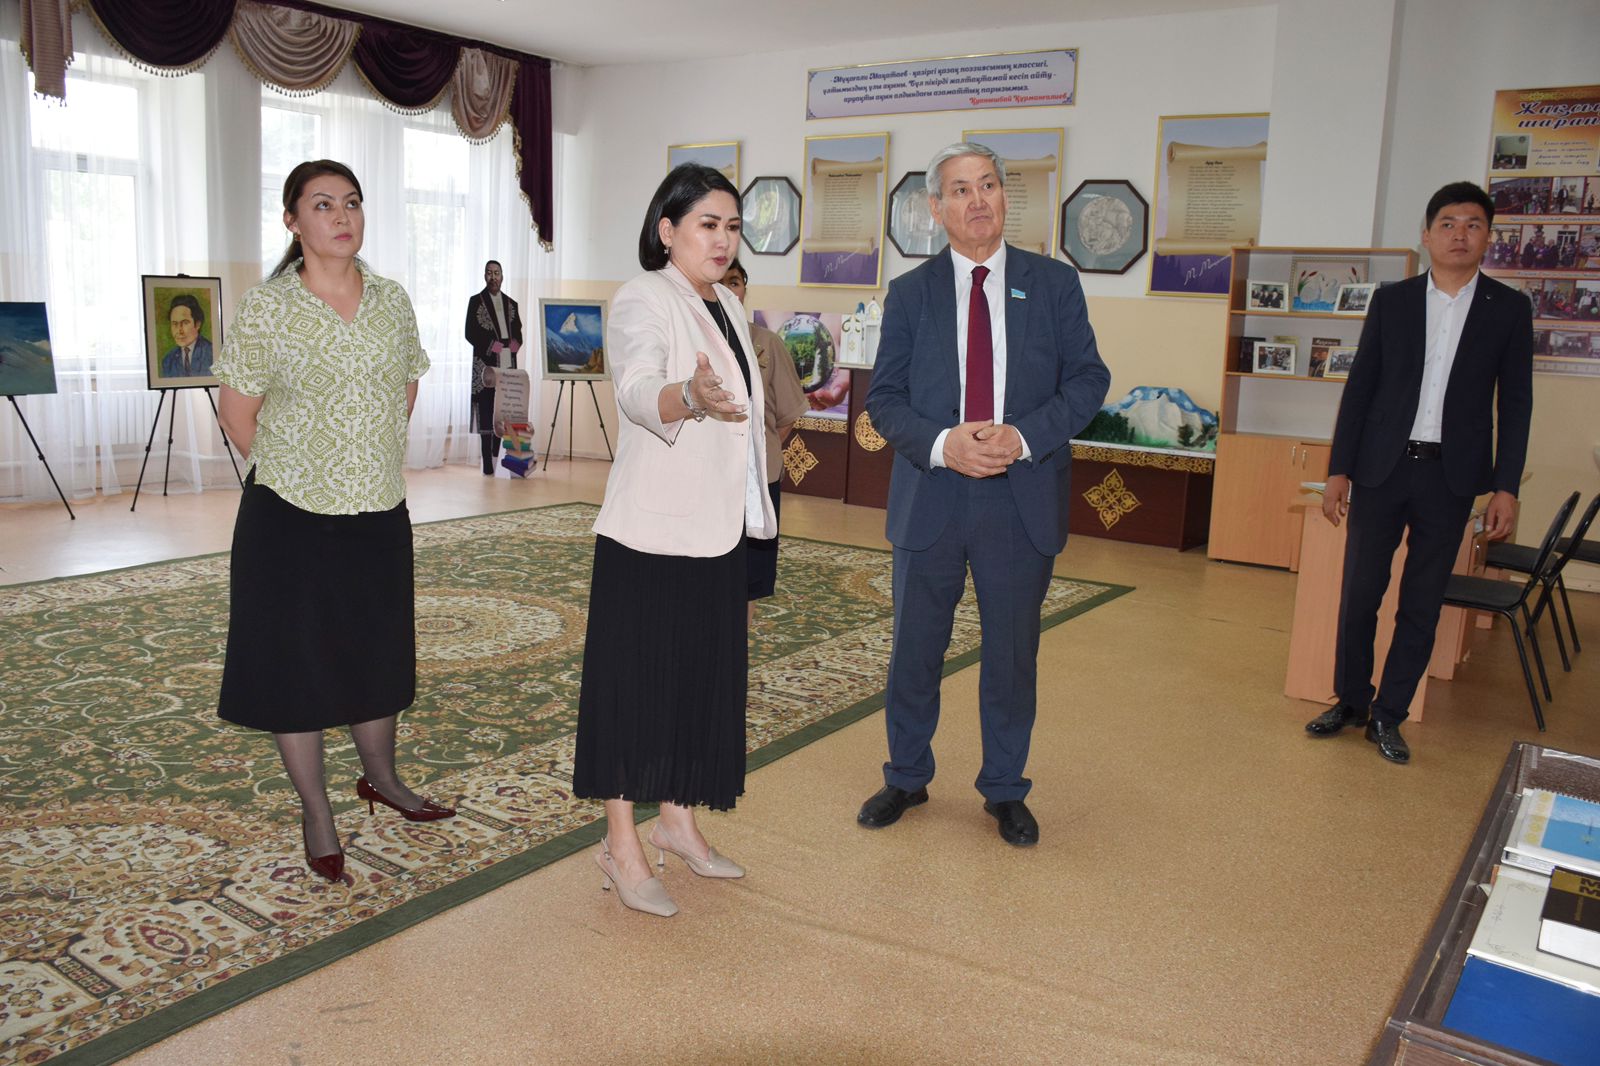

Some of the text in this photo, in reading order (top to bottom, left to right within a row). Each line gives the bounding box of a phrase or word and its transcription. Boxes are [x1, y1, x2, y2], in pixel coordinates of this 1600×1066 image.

[912, 67, 937, 78] қазіргі
[938, 66, 959, 76] қазақ
[960, 64, 1012, 74] поэзиясының
